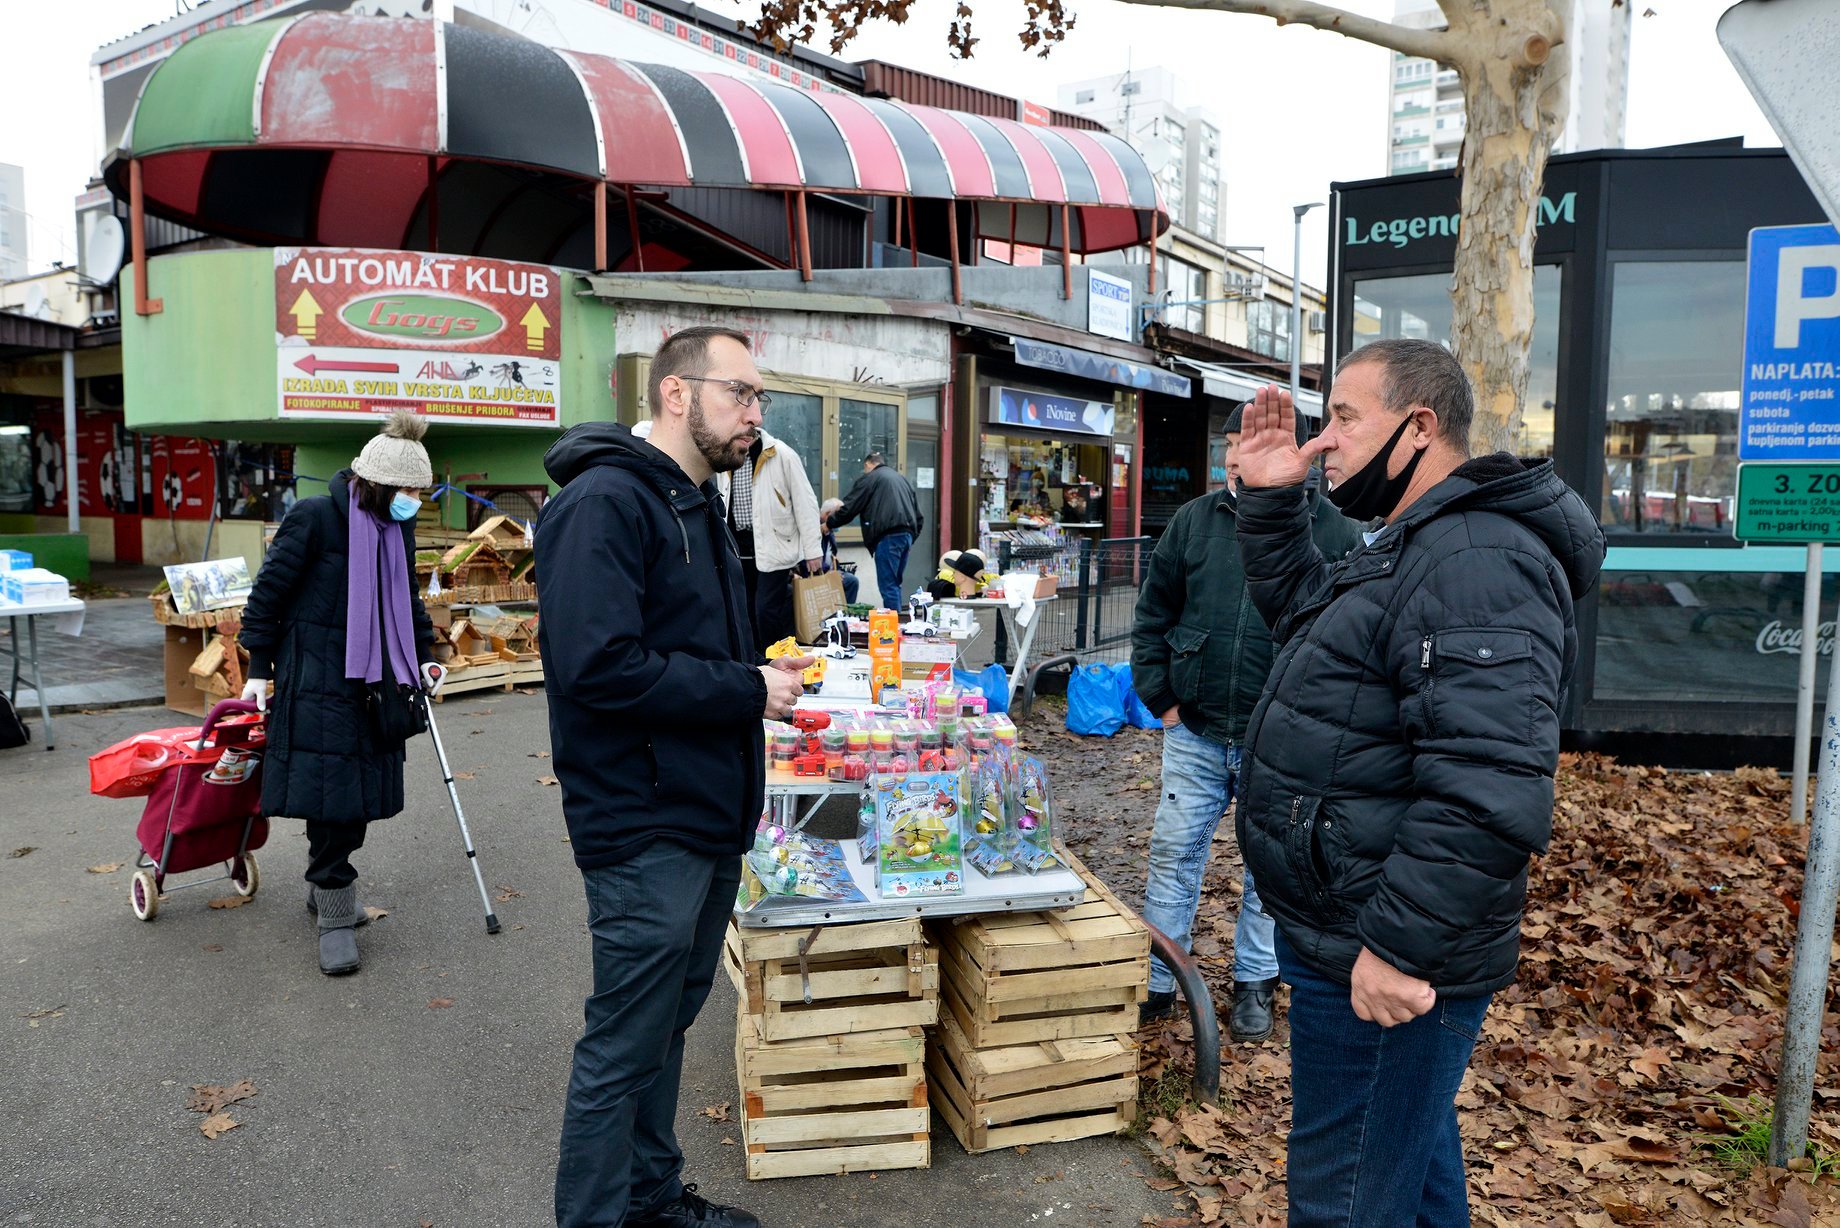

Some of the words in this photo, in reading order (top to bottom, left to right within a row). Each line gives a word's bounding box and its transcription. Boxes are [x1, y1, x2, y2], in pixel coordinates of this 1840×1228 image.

[290, 257, 455, 289] AUTOMAT
[465, 265, 550, 298] KLUB
[1092, 279, 1118, 299] SPORT
[1773, 244, 1840, 349] P
[367, 300, 480, 337] Gogs
[1028, 346, 1066, 366] TOBACCO
[283, 378, 348, 394] IZRADA
[353, 381, 398, 396] SVIH
[403, 383, 464, 399] VRSTA
[469, 385, 555, 404] KLJUČEVA
[287, 398, 361, 411] FOTOKOPIRANJE
[425, 402, 473, 415] BRUŠENJE
[475, 405, 515, 417] PRIBORA
[1046, 403, 1077, 422] iNovine
[1749, 406, 1790, 418] subota
[1747, 421, 1806, 436] parkiranje
[1746, 434, 1805, 448] kupljenom
[1775, 473, 1795, 494] 3.
[1807, 473, 1840, 494] ZO
[1748, 497, 1781, 506] dnevna
[1784, 497, 1808, 506] karta
[1748, 508, 1773, 516] satna
[1776, 507, 1800, 516] karta
[1757, 520, 1830, 534] m-parking
